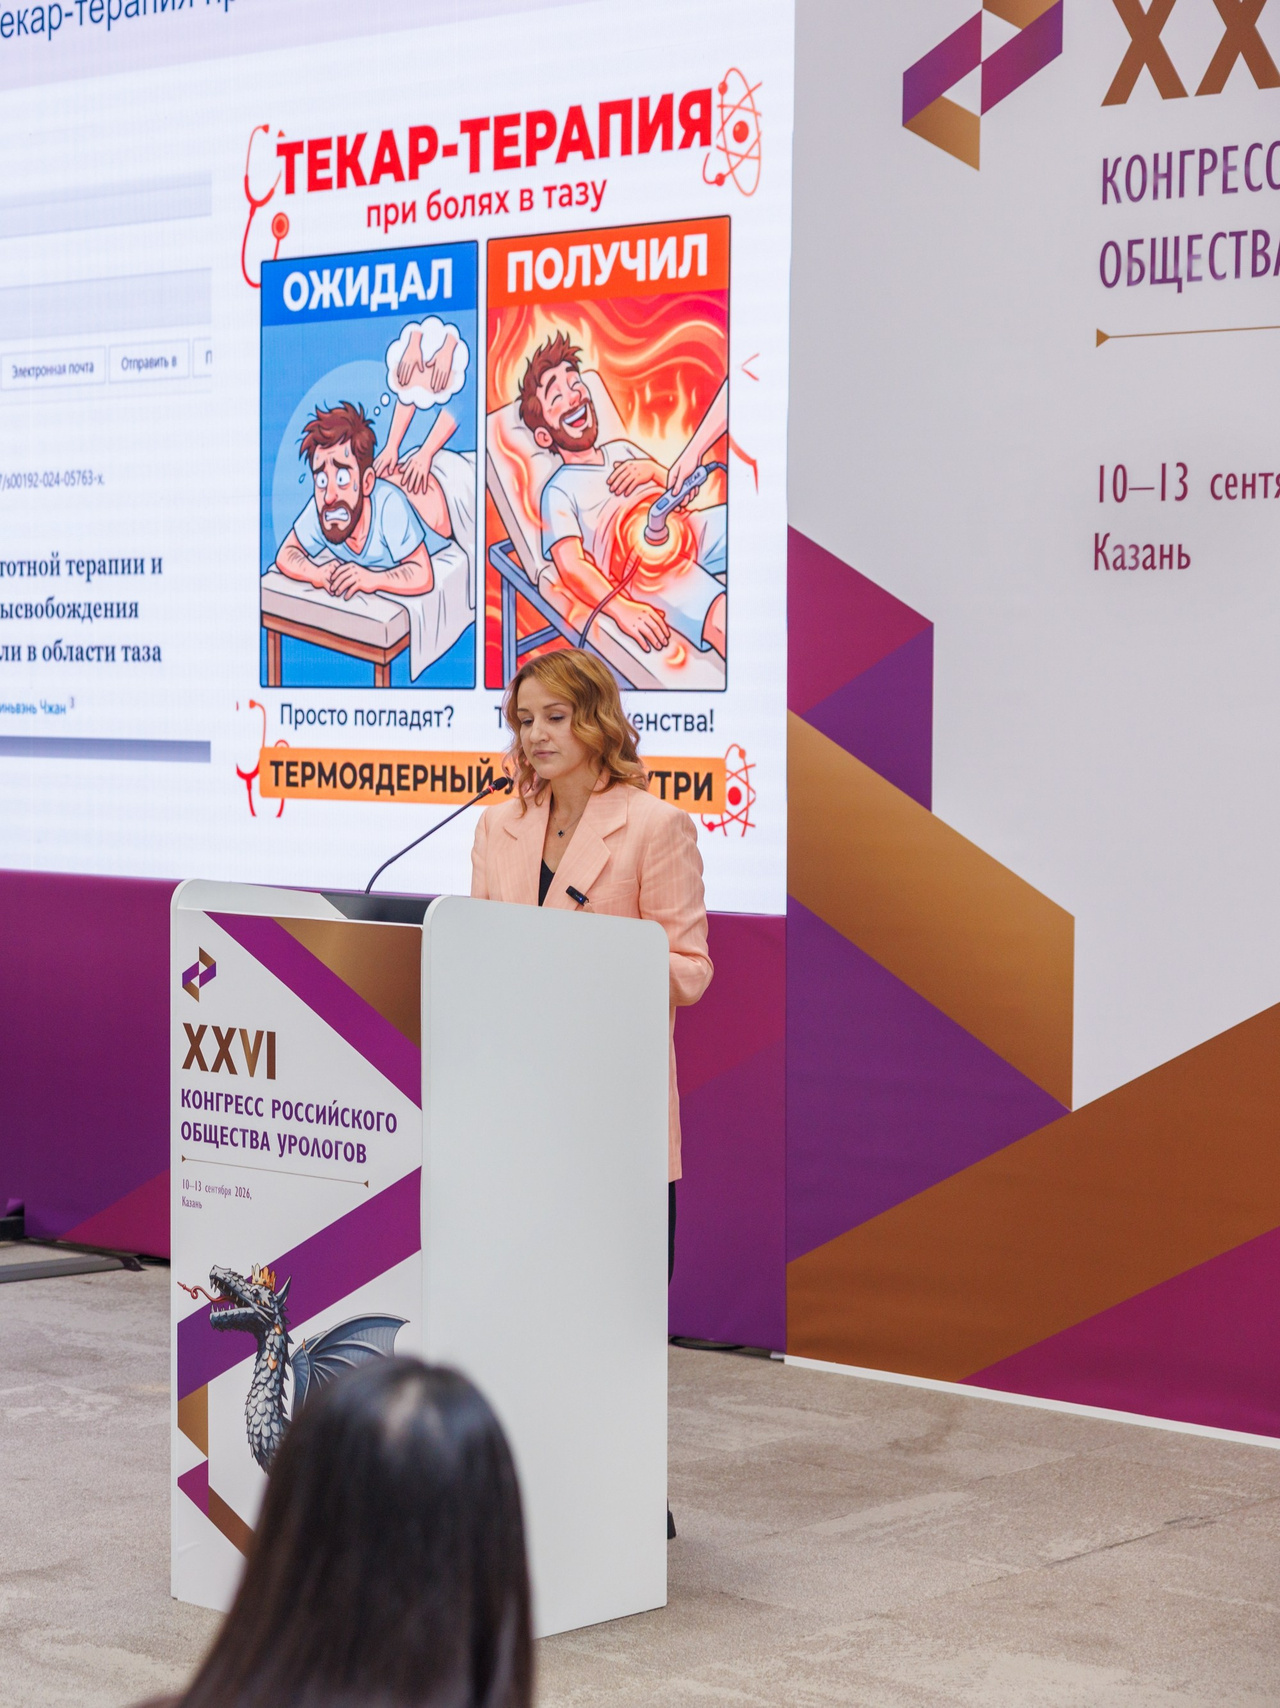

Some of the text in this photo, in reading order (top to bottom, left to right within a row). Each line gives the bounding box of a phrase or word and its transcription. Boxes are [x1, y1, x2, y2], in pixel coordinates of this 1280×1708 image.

[276, 87, 713, 195] ТЕКАР-ТЕРАПИЯ
[366, 178, 608, 234] при болях в тазу
[507, 234, 708, 293] ПОЛУЧИЛ
[282, 259, 454, 314] ОЖИДАЛ
[11, 360, 94, 379] Электронная почта
[121, 354, 169, 373] Отправить
[65, 556, 145, 581] терапии
[151, 556, 163, 574] и
[1094, 532, 1191, 571] Казань
[26, 643, 37, 662] в
[42, 639, 116, 662] области
[121, 643, 162, 662] таза
[280, 704, 455, 733] Просто погладят?
[626, 708, 715, 732] енства!
[270, 758, 494, 796] ТЕРМОЯДЕРНЫЙ
[181, 1022, 277, 1080] XXVI
[181, 1088, 398, 1134] КОНГРЕСС РОССИЙСКОГО
[181, 1121, 367, 1164] ОБЩЕСТВА УРОЛОГОВ
[181, 1196, 202, 1209] Казань
[205, 1184, 231, 1198] сентября
